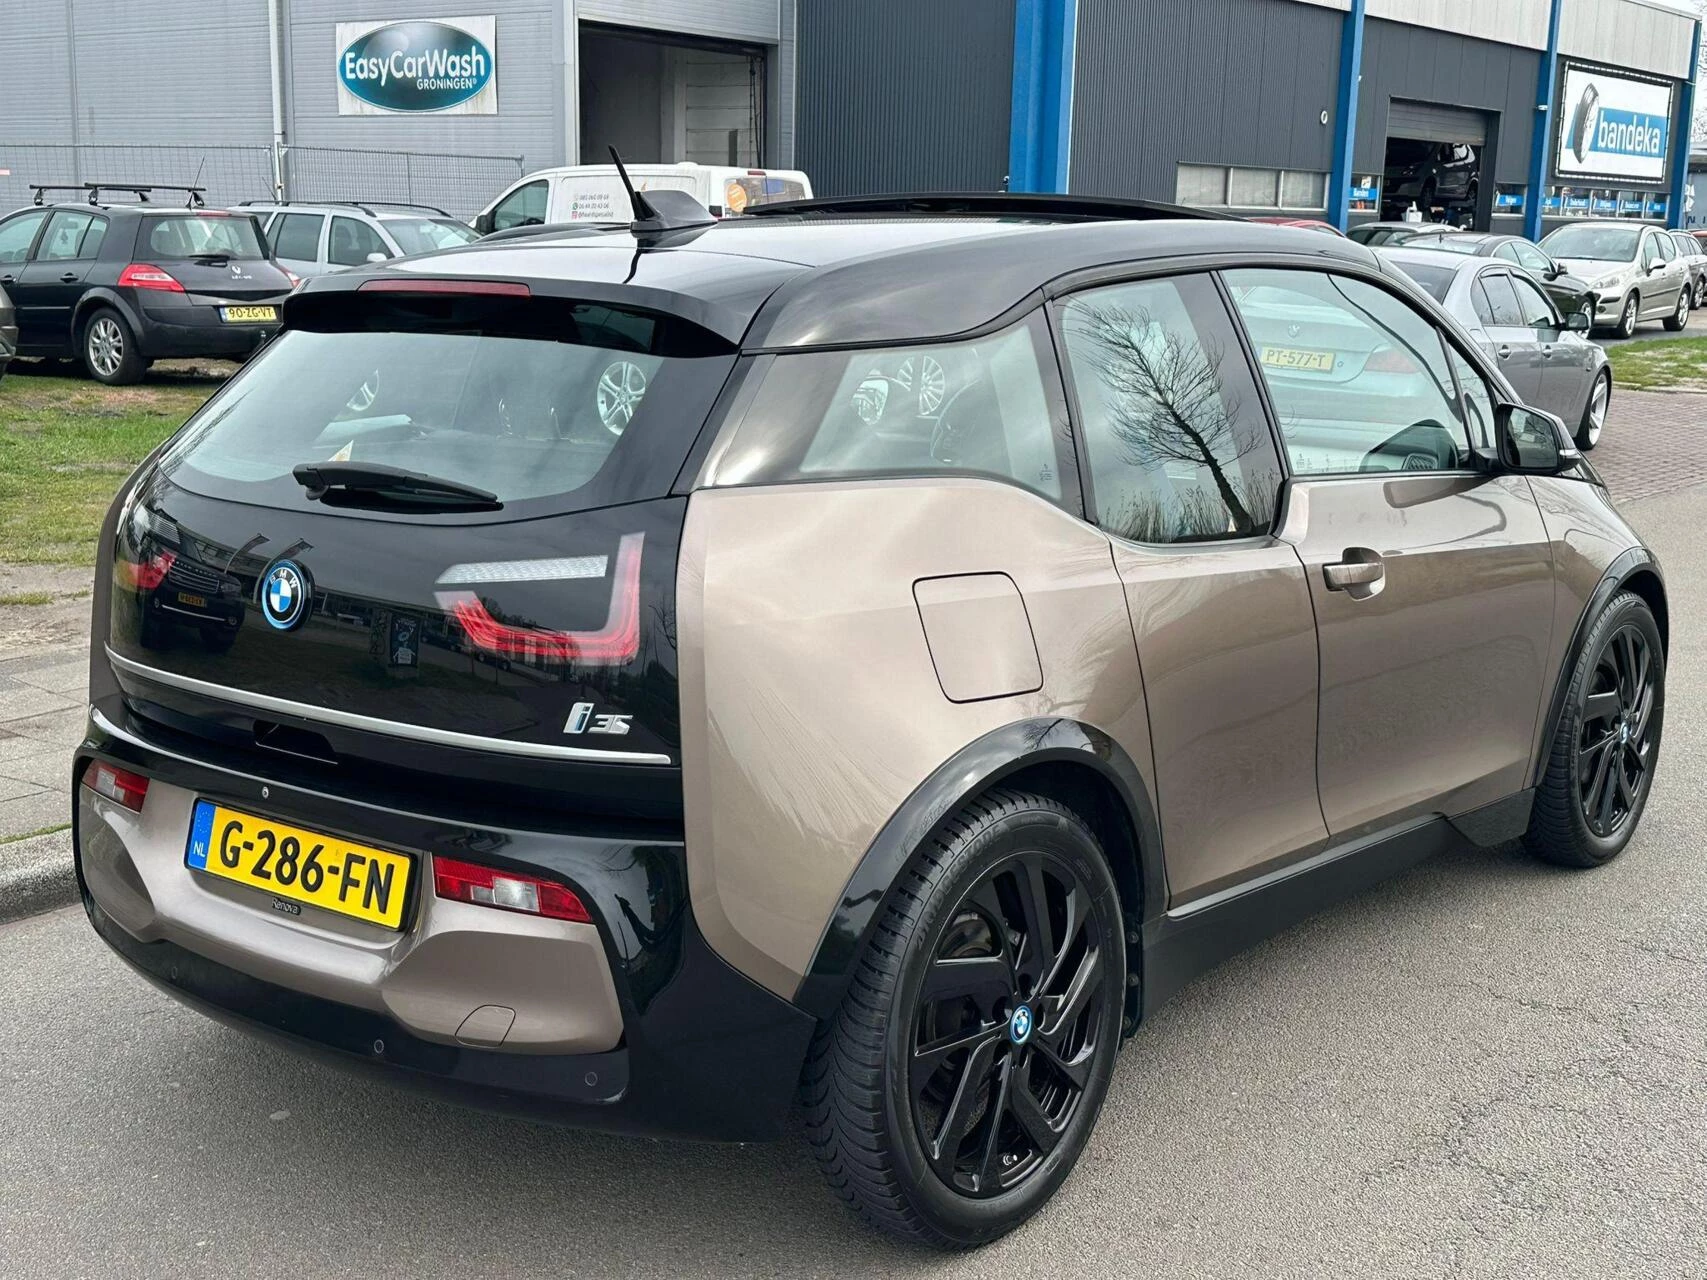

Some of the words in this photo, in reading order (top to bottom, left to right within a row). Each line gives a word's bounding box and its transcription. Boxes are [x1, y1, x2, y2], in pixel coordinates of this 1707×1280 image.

[345, 45, 485, 87] EasyCarWash
[1597, 110, 1661, 154] bandeka
[229, 307, 271, 318] 90-ZG-VT
[1266, 350, 1326, 367] PT-577-T
[269, 569, 299, 589] BMW
[193, 843, 206, 858] NL
[220, 820, 395, 914] G-286-FN
[272, 897, 298, 914] Renova
